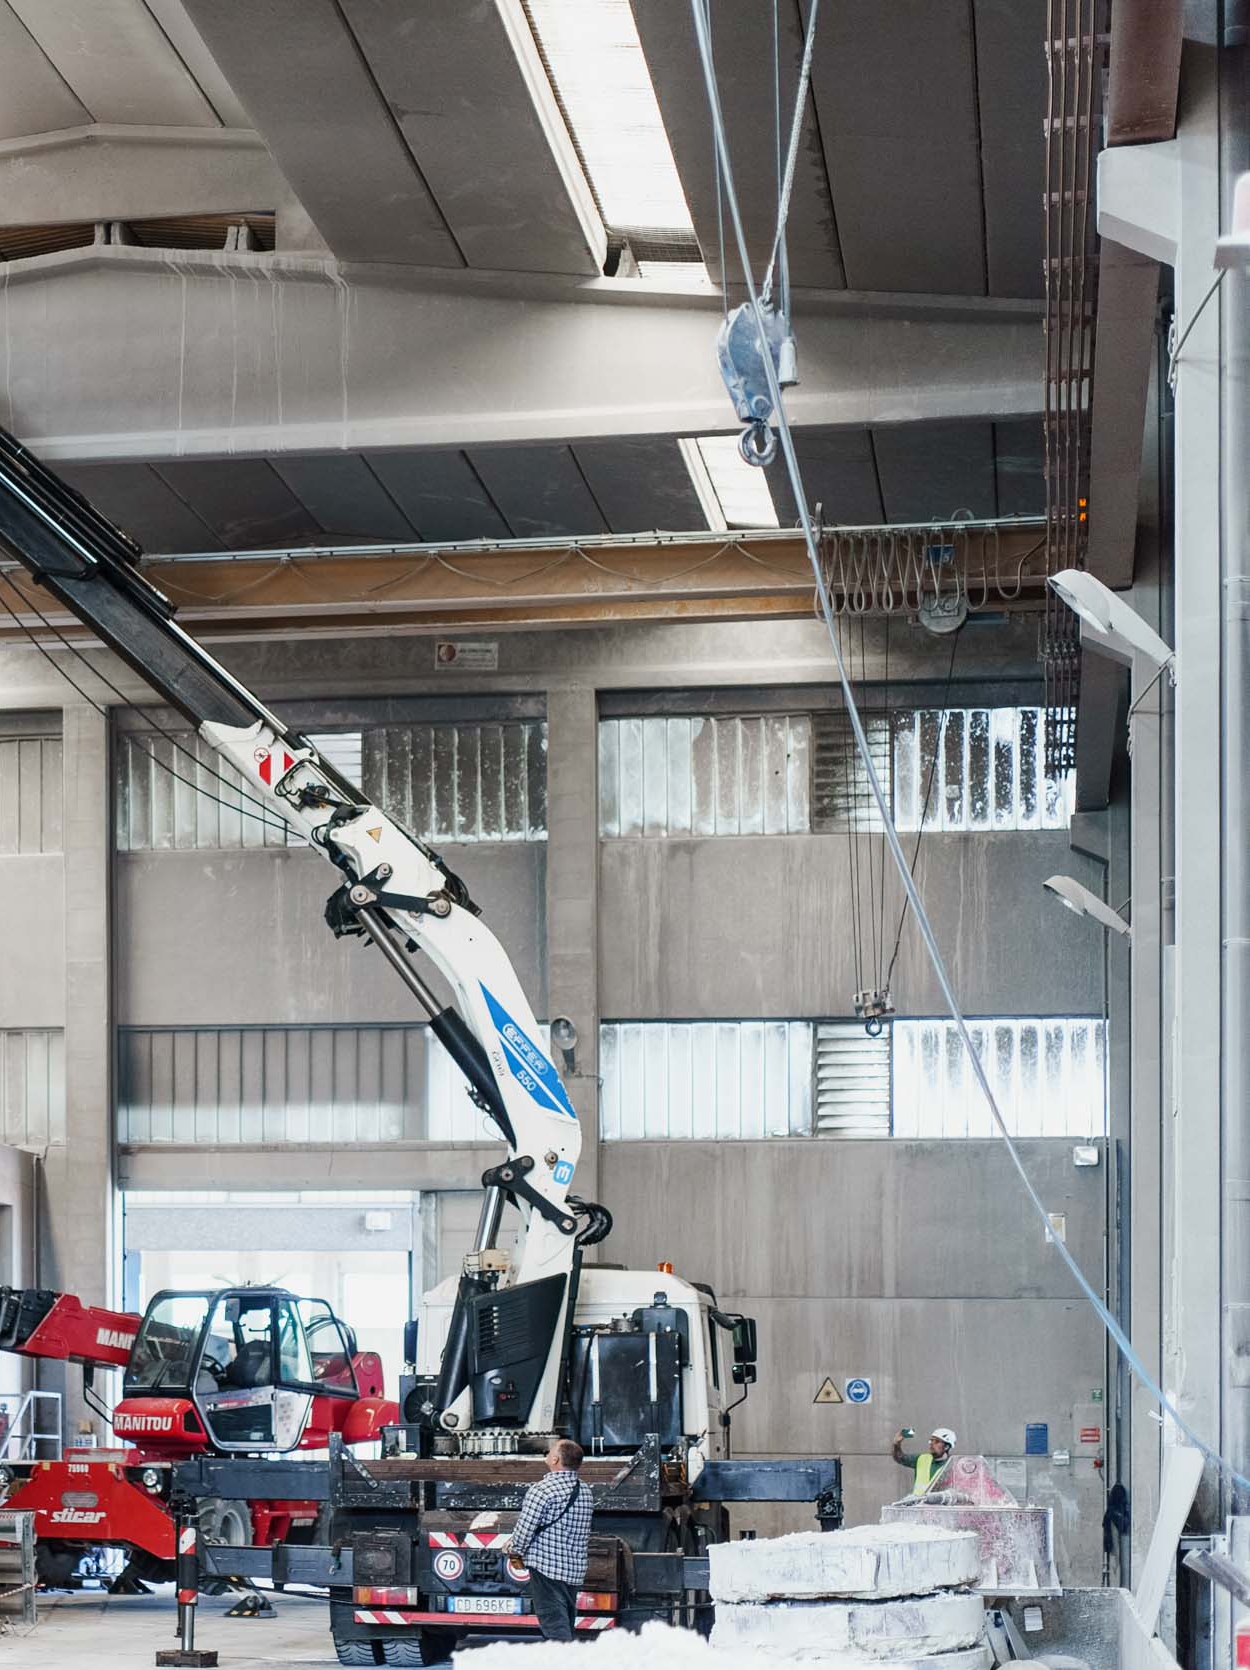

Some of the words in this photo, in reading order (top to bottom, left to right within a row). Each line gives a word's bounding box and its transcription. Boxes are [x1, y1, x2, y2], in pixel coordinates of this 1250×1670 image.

[504, 1025, 547, 1074] EFFER
[114, 1416, 172, 1431] MANITOU
[50, 1507, 106, 1523] sticar
[443, 1560, 456, 1570] 70
